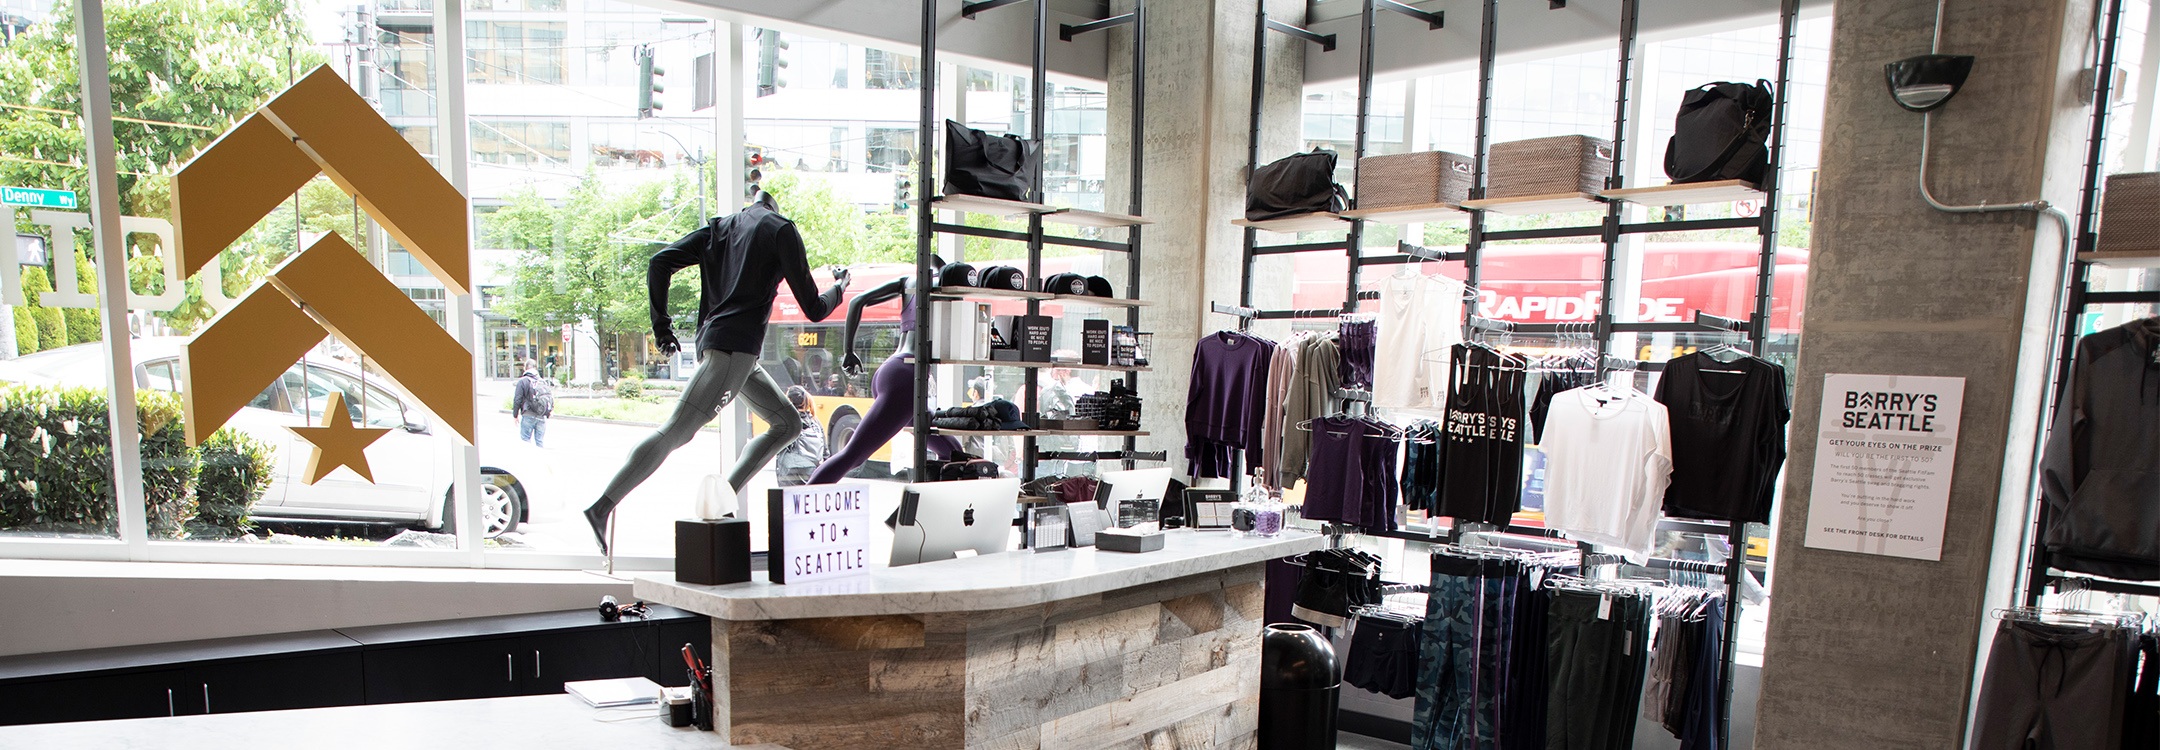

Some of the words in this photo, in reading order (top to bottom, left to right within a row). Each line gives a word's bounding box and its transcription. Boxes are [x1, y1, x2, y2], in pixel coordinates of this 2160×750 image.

[5, 188, 45, 206] Denny
[59, 195, 73, 207] Wy
[797, 332, 818, 346] 6211
[1844, 391, 1938, 412] BARRY'S
[1448, 421, 1486, 437] EATTLE
[1842, 411, 1935, 433] SEATTLE
[1919, 444, 1942, 452] PRIZE
[792, 490, 860, 515] WELCOME
[820, 523, 837, 543] TO
[795, 549, 863, 576] SEATTLE
